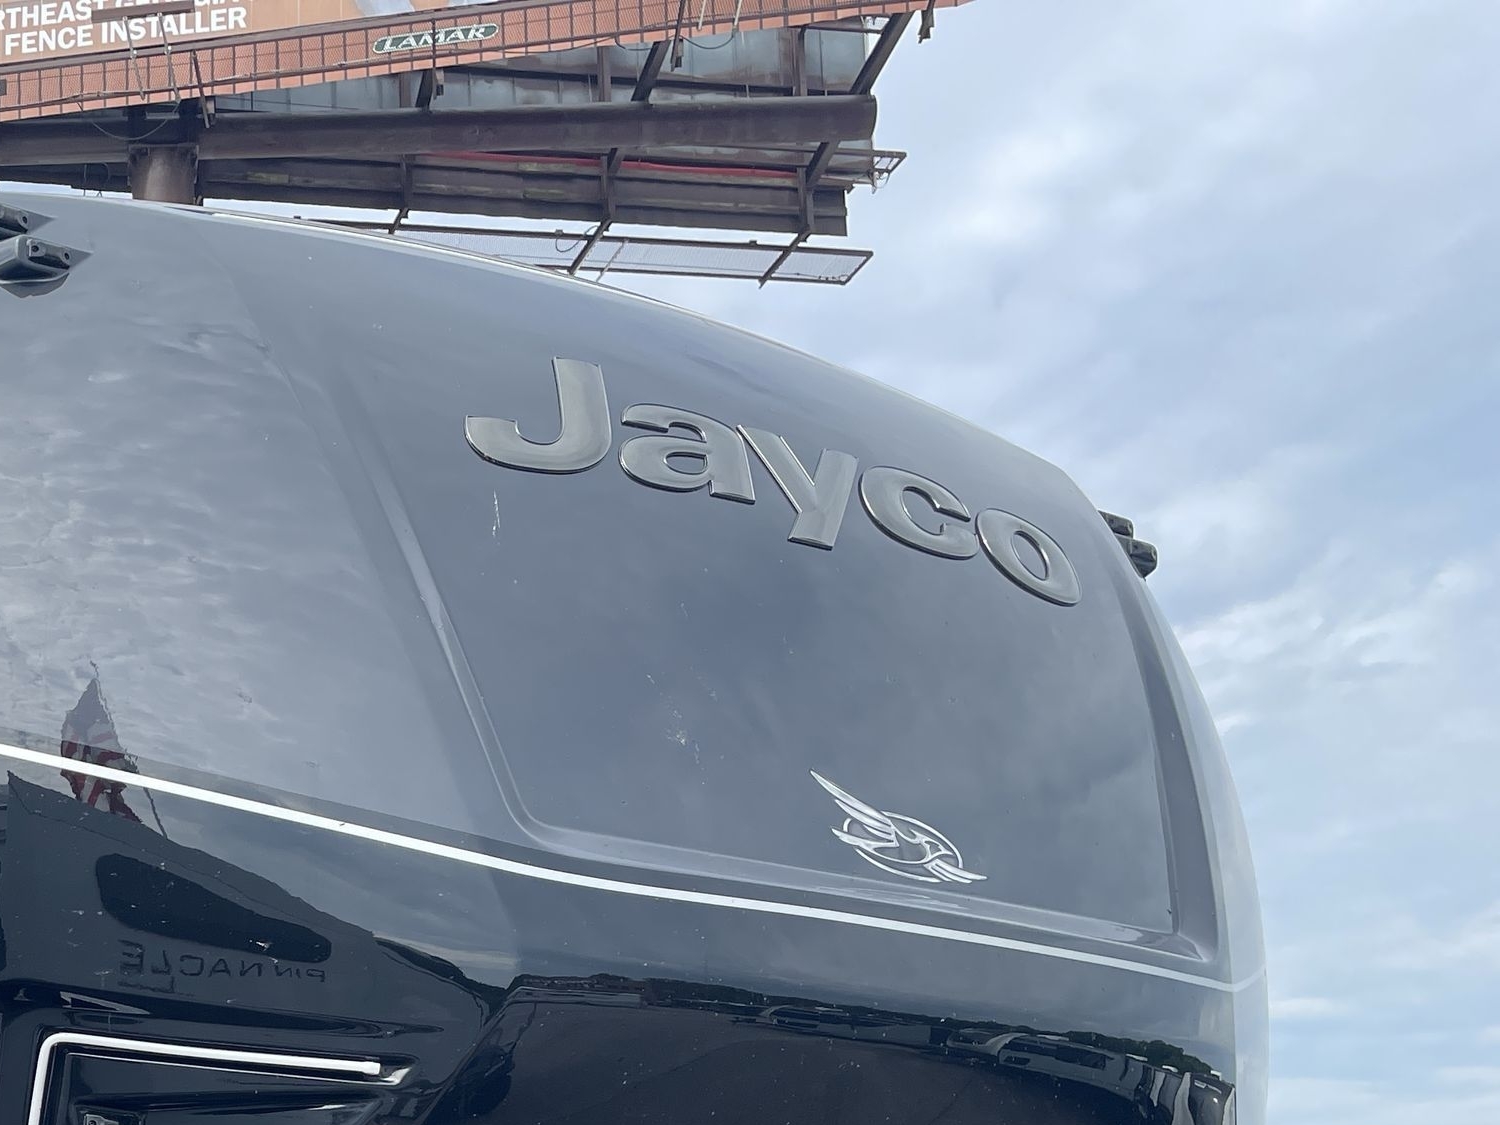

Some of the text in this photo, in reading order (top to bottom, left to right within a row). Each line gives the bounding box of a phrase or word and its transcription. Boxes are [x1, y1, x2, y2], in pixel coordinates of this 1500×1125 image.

[4, 24, 94, 56] FENCE
[101, 6, 248, 44] INSTALLER
[382, 27, 486, 50] LAMAR
[463, 356, 1083, 607] Jayco
